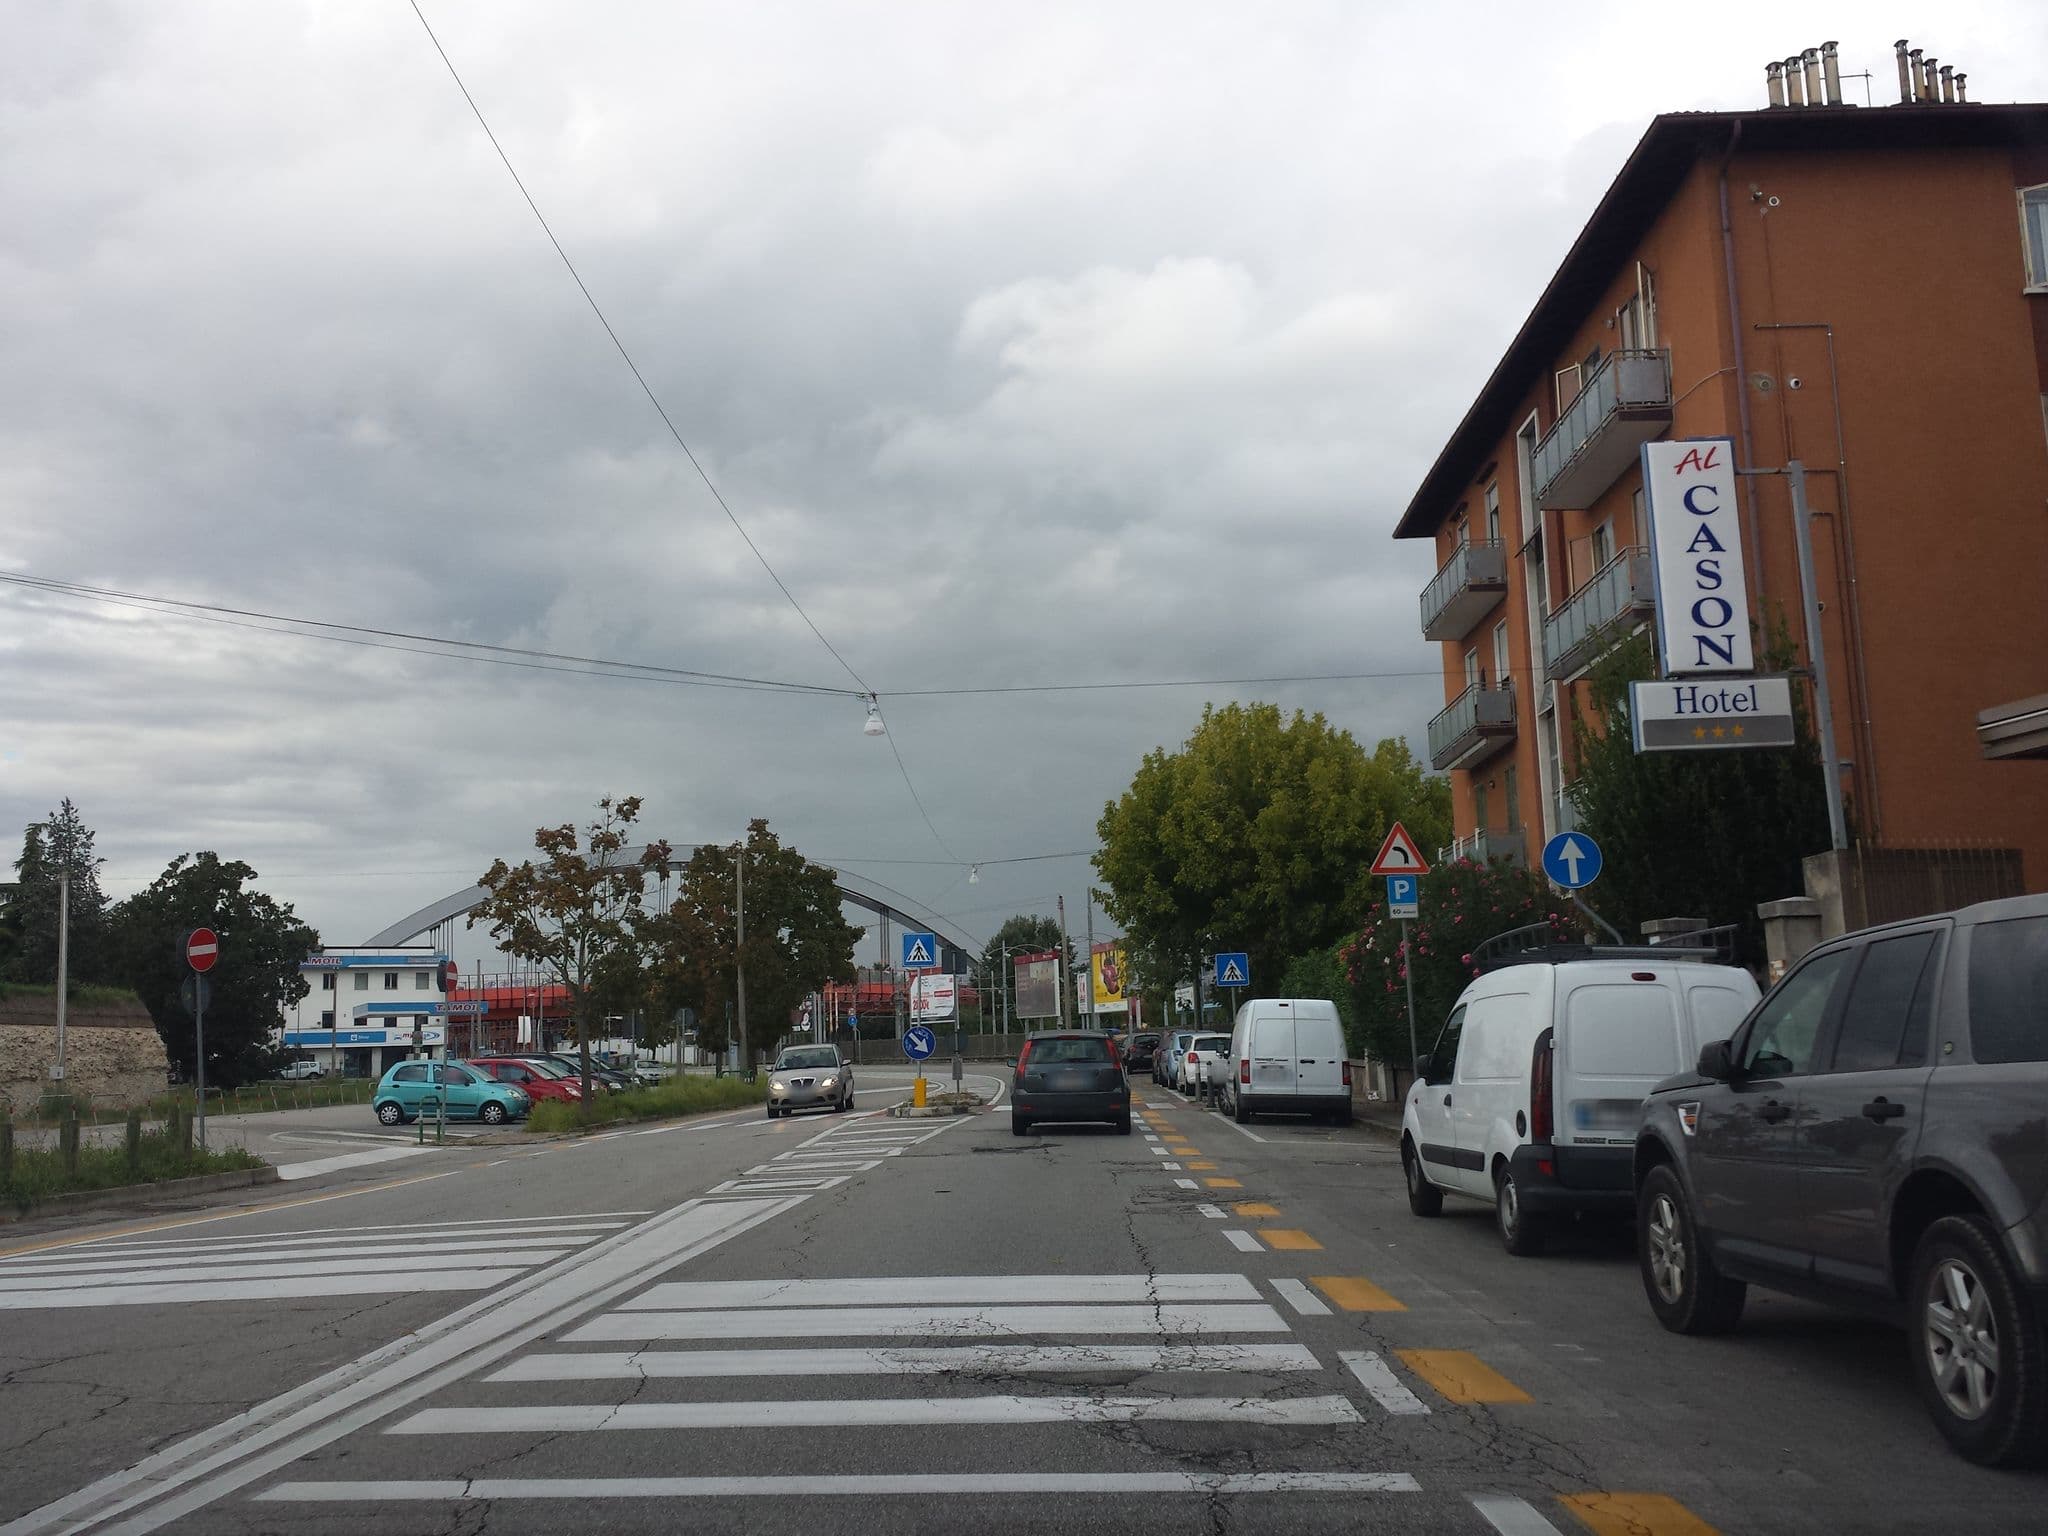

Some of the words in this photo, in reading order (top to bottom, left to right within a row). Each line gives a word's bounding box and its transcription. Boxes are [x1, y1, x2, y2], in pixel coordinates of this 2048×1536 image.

[1674, 446, 1721, 475] AL
[1683, 485, 1736, 667] CASON
[1674, 685, 1759, 715] Hotel
[1394, 880, 1409, 900] P
